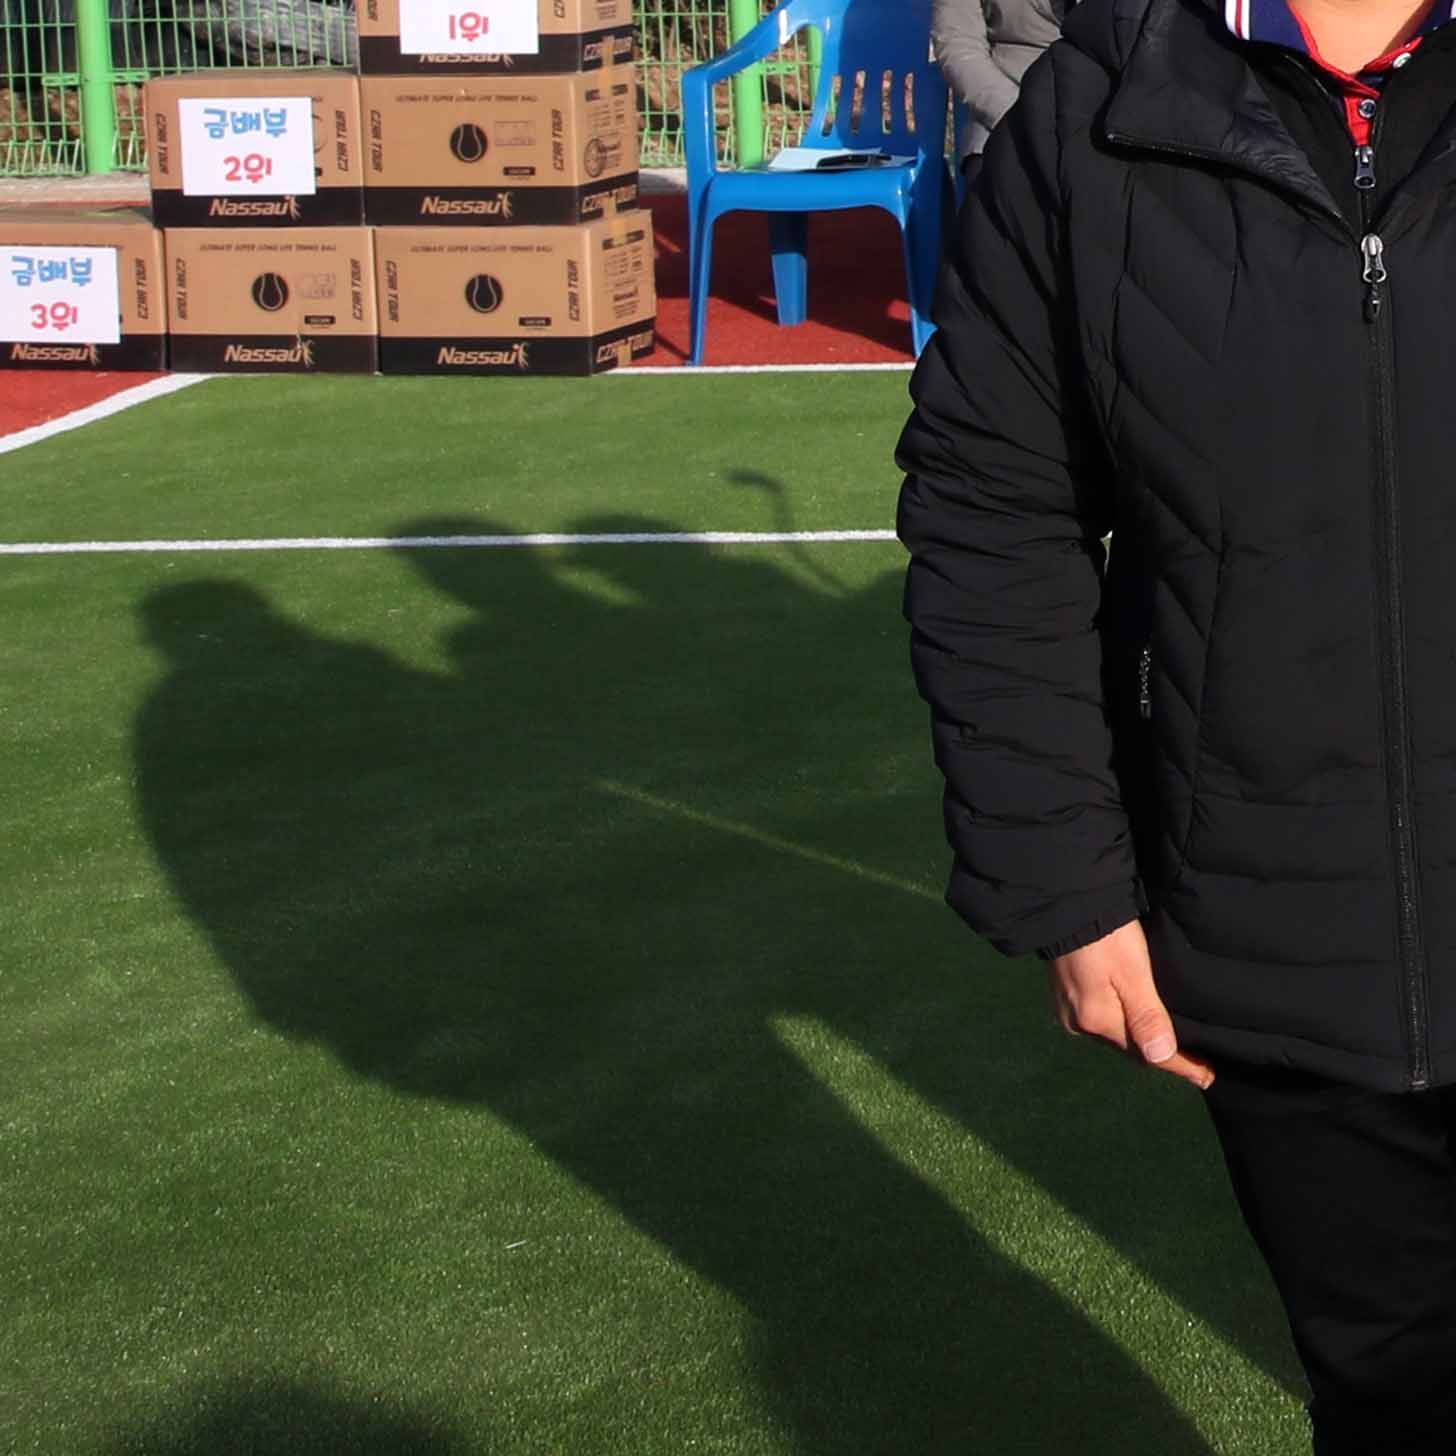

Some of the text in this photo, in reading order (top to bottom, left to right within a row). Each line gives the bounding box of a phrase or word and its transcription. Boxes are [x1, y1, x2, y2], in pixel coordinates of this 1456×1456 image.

[449, 11, 489, 42] 1위
[223, 153, 273, 183] 2위
[209, 198, 289, 216] Nassau
[420, 196, 500, 215] Nassau
[30, 301, 78, 331] 3위
[11, 344, 89, 361] Nassau
[224, 345, 300, 362] Nassau
[437, 347, 515, 365] Nassau
